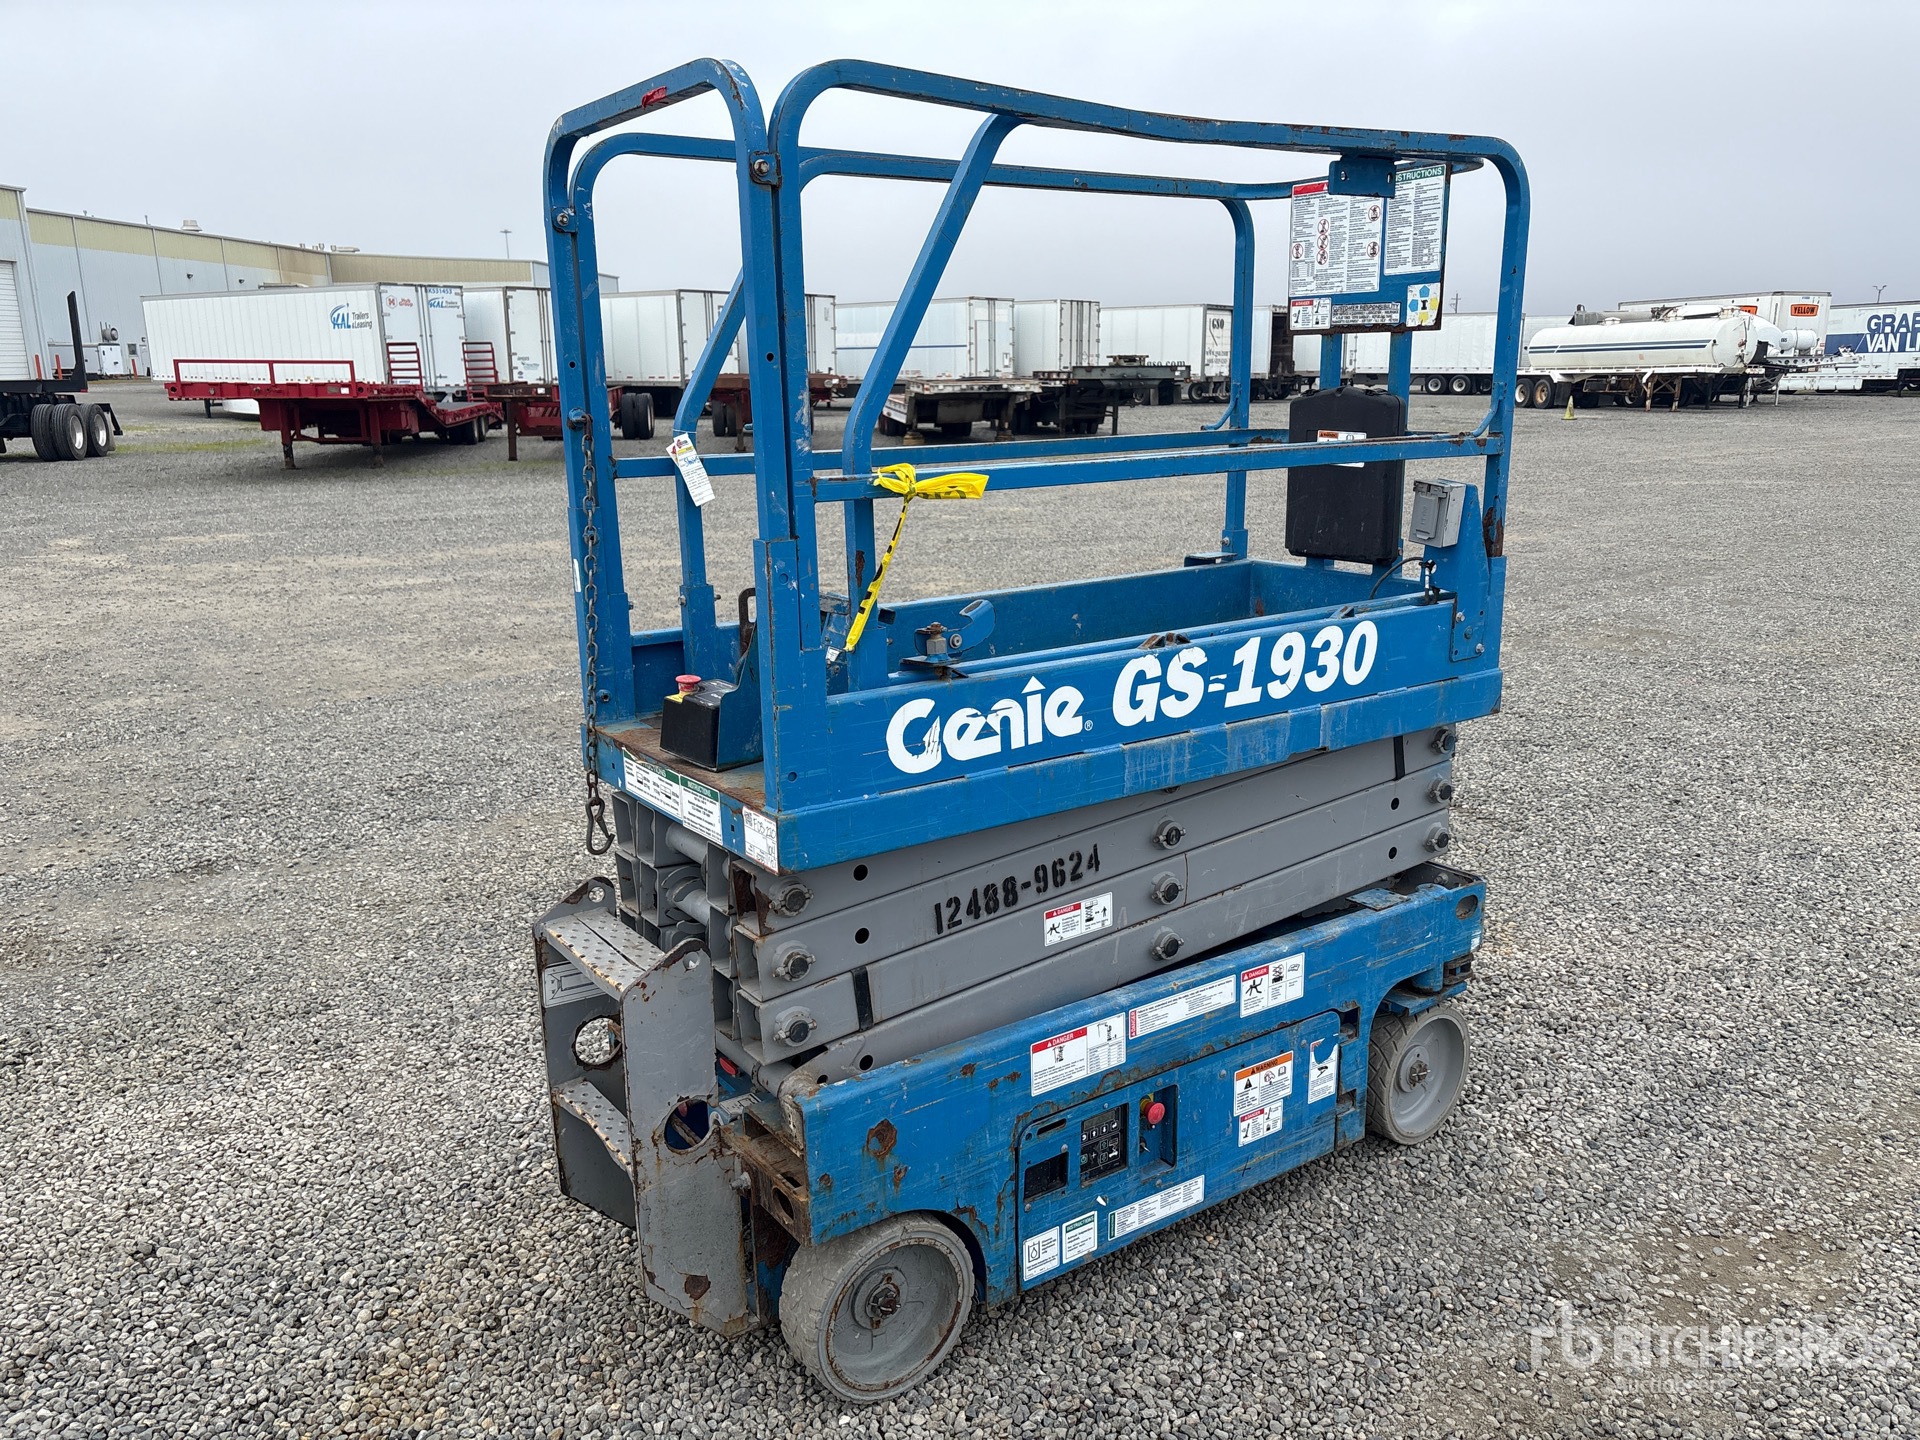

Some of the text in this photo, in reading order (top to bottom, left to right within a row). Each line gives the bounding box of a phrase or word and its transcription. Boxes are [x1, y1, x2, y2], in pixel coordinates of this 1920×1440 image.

[352, 312, 369, 320] Trailers
[1794, 306, 1816, 315] YELLOW
[1212, 318, 1225, 330] GSO
[1866, 333, 1900, 352] VAN
[886, 676, 1085, 774] Genie
[934, 843, 1101, 935] 12488-9624
[1057, 906, 1075, 915] DANGER
[1248, 968, 1268, 978] DANGER
[1053, 1033, 1074, 1046] DANGER
[1257, 1058, 1278, 1073] WARNING
[1067, 1214, 1094, 1232] INSTRUCTIONS
